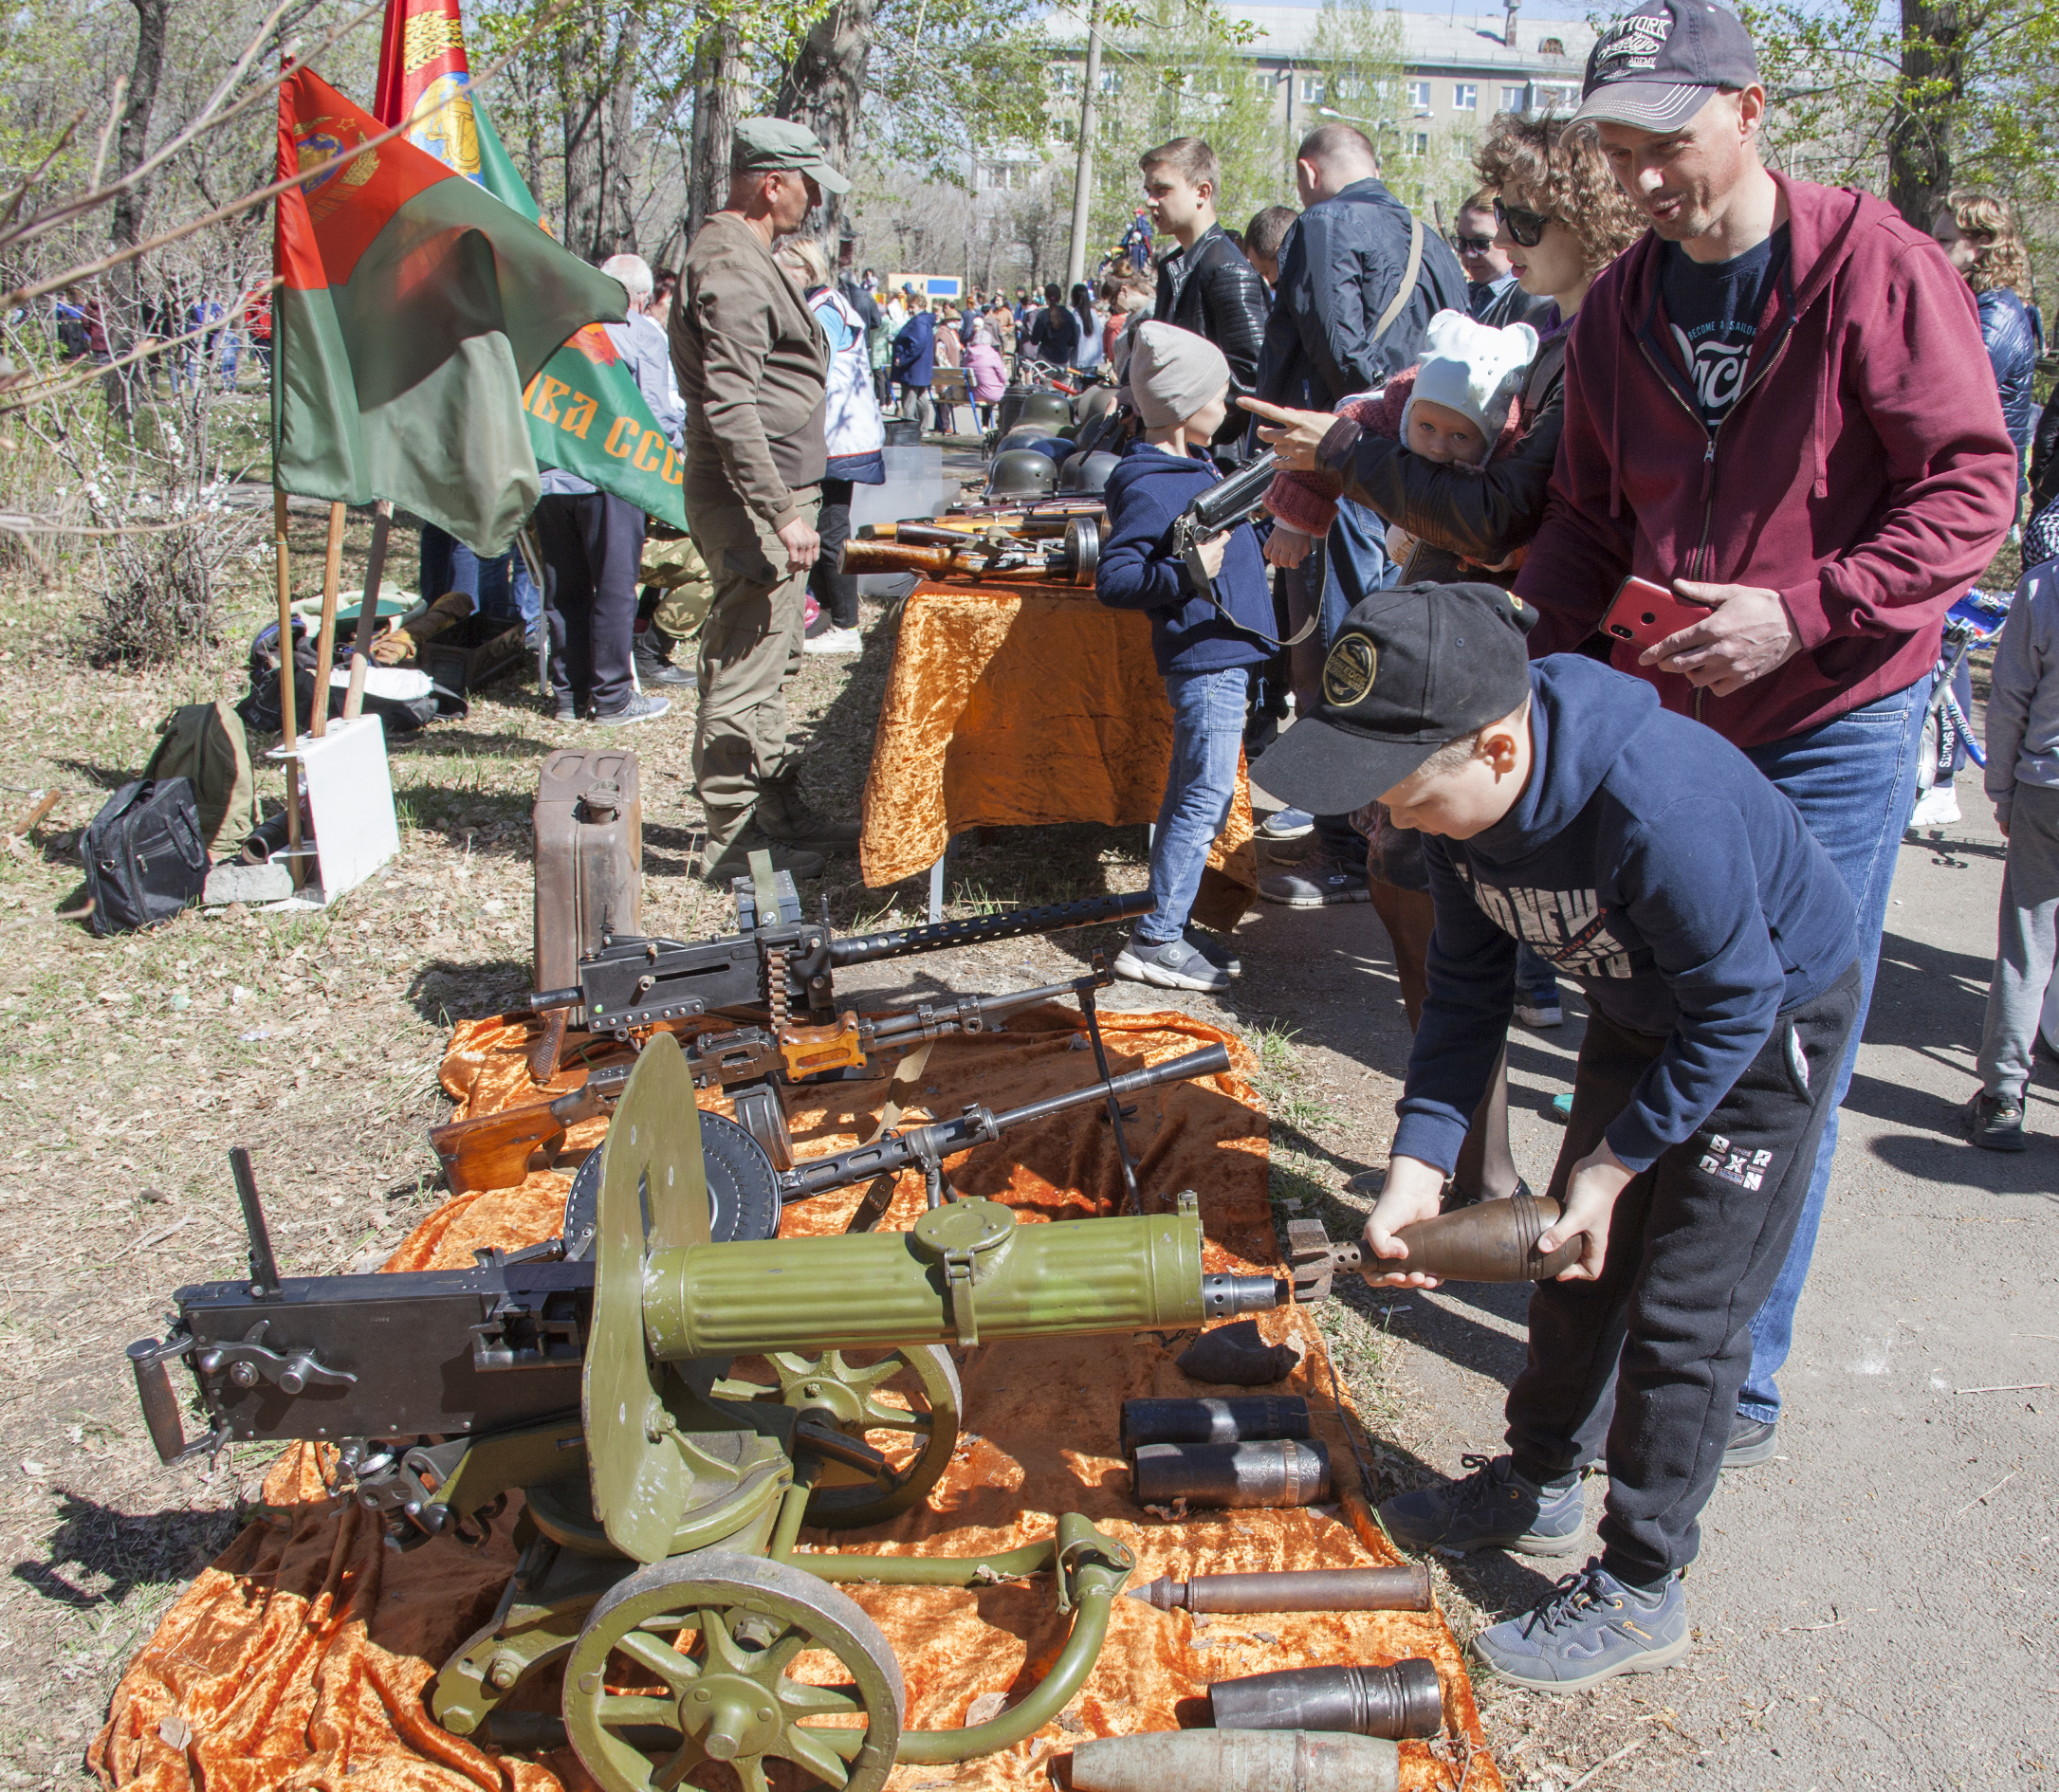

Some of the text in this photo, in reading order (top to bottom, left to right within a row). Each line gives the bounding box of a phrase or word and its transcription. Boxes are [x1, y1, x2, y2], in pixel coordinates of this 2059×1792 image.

[1687, 320, 1716, 341] BECOME
[1719, 320, 1724, 330] A
[1948, 704, 1977, 747] meteor
[1939, 730, 1955, 768] SPORTS
